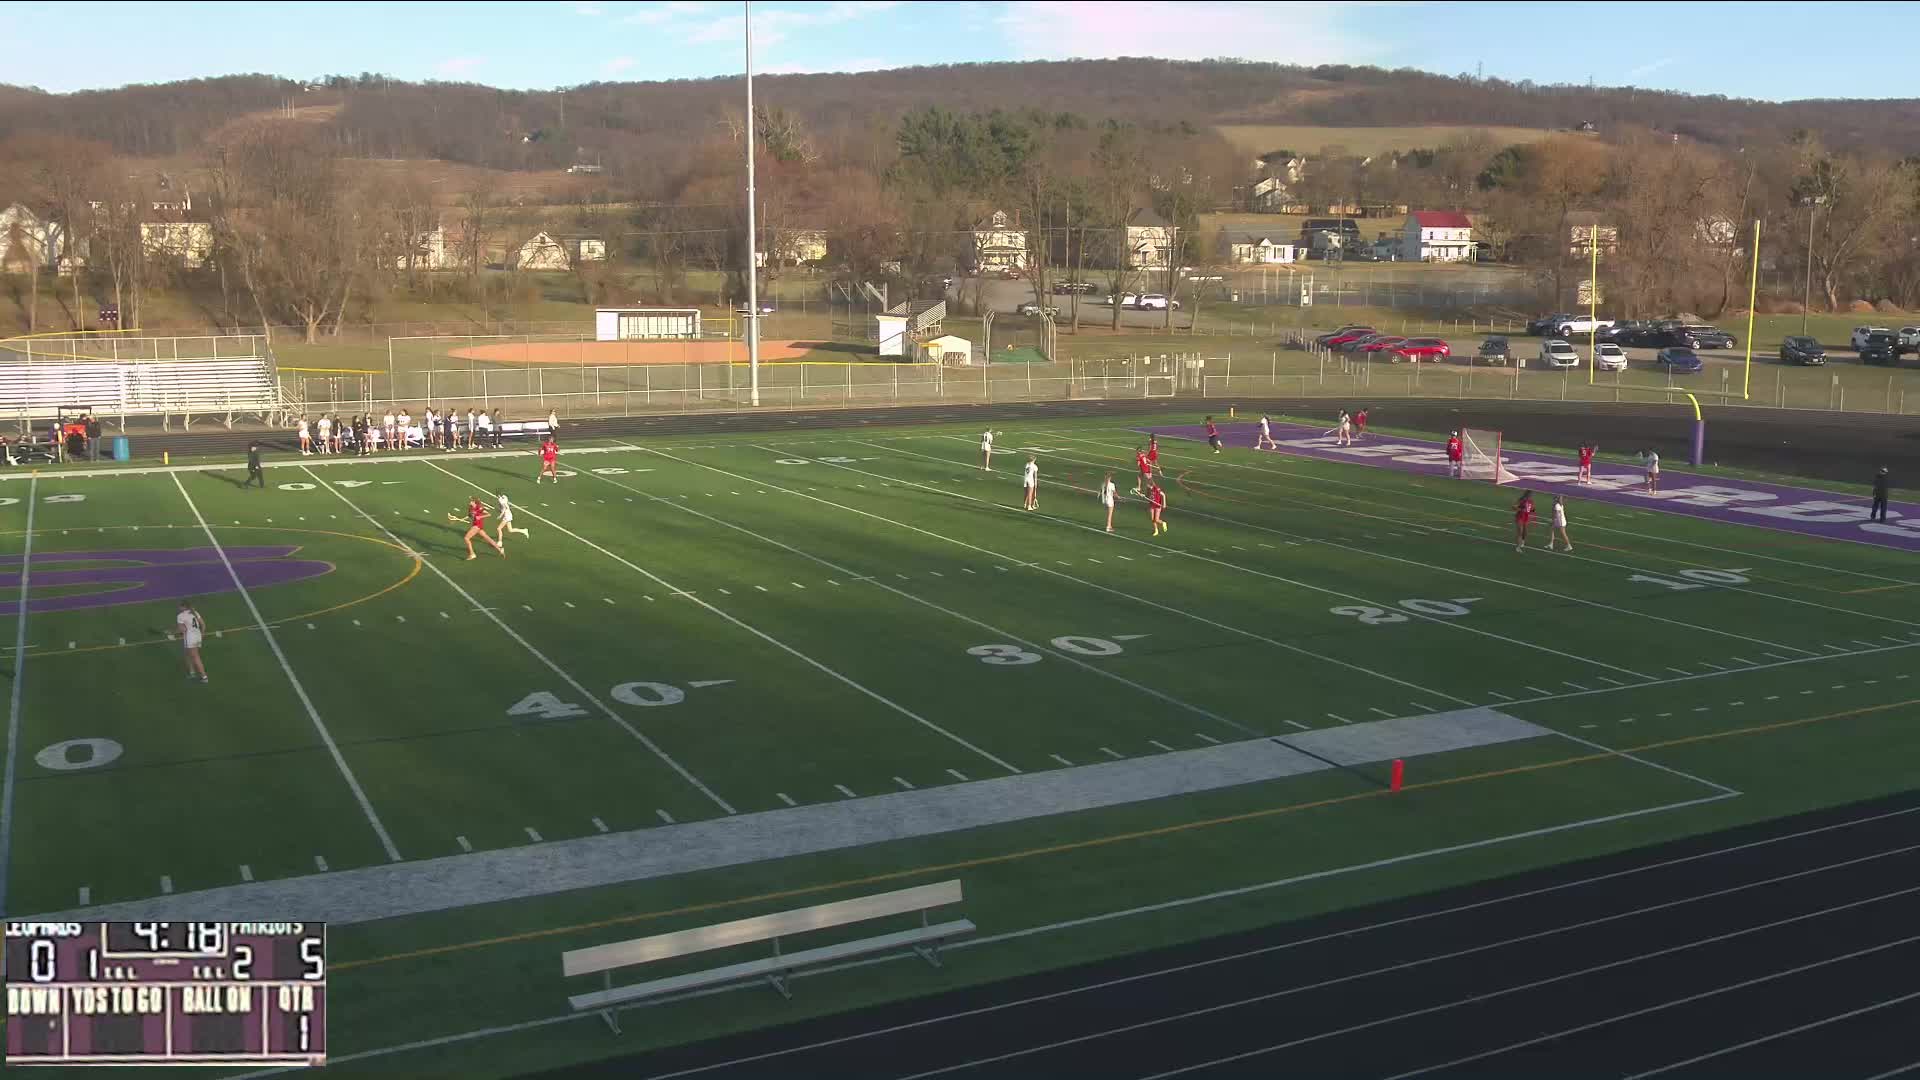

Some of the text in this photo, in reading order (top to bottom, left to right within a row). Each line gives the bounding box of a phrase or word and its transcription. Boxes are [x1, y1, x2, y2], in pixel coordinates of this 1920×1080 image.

[1627, 569, 1750, 589] 10
[1329, 599, 1471, 625] 20
[966, 636, 1124, 665] 30
[506, 681, 686, 719] 40
